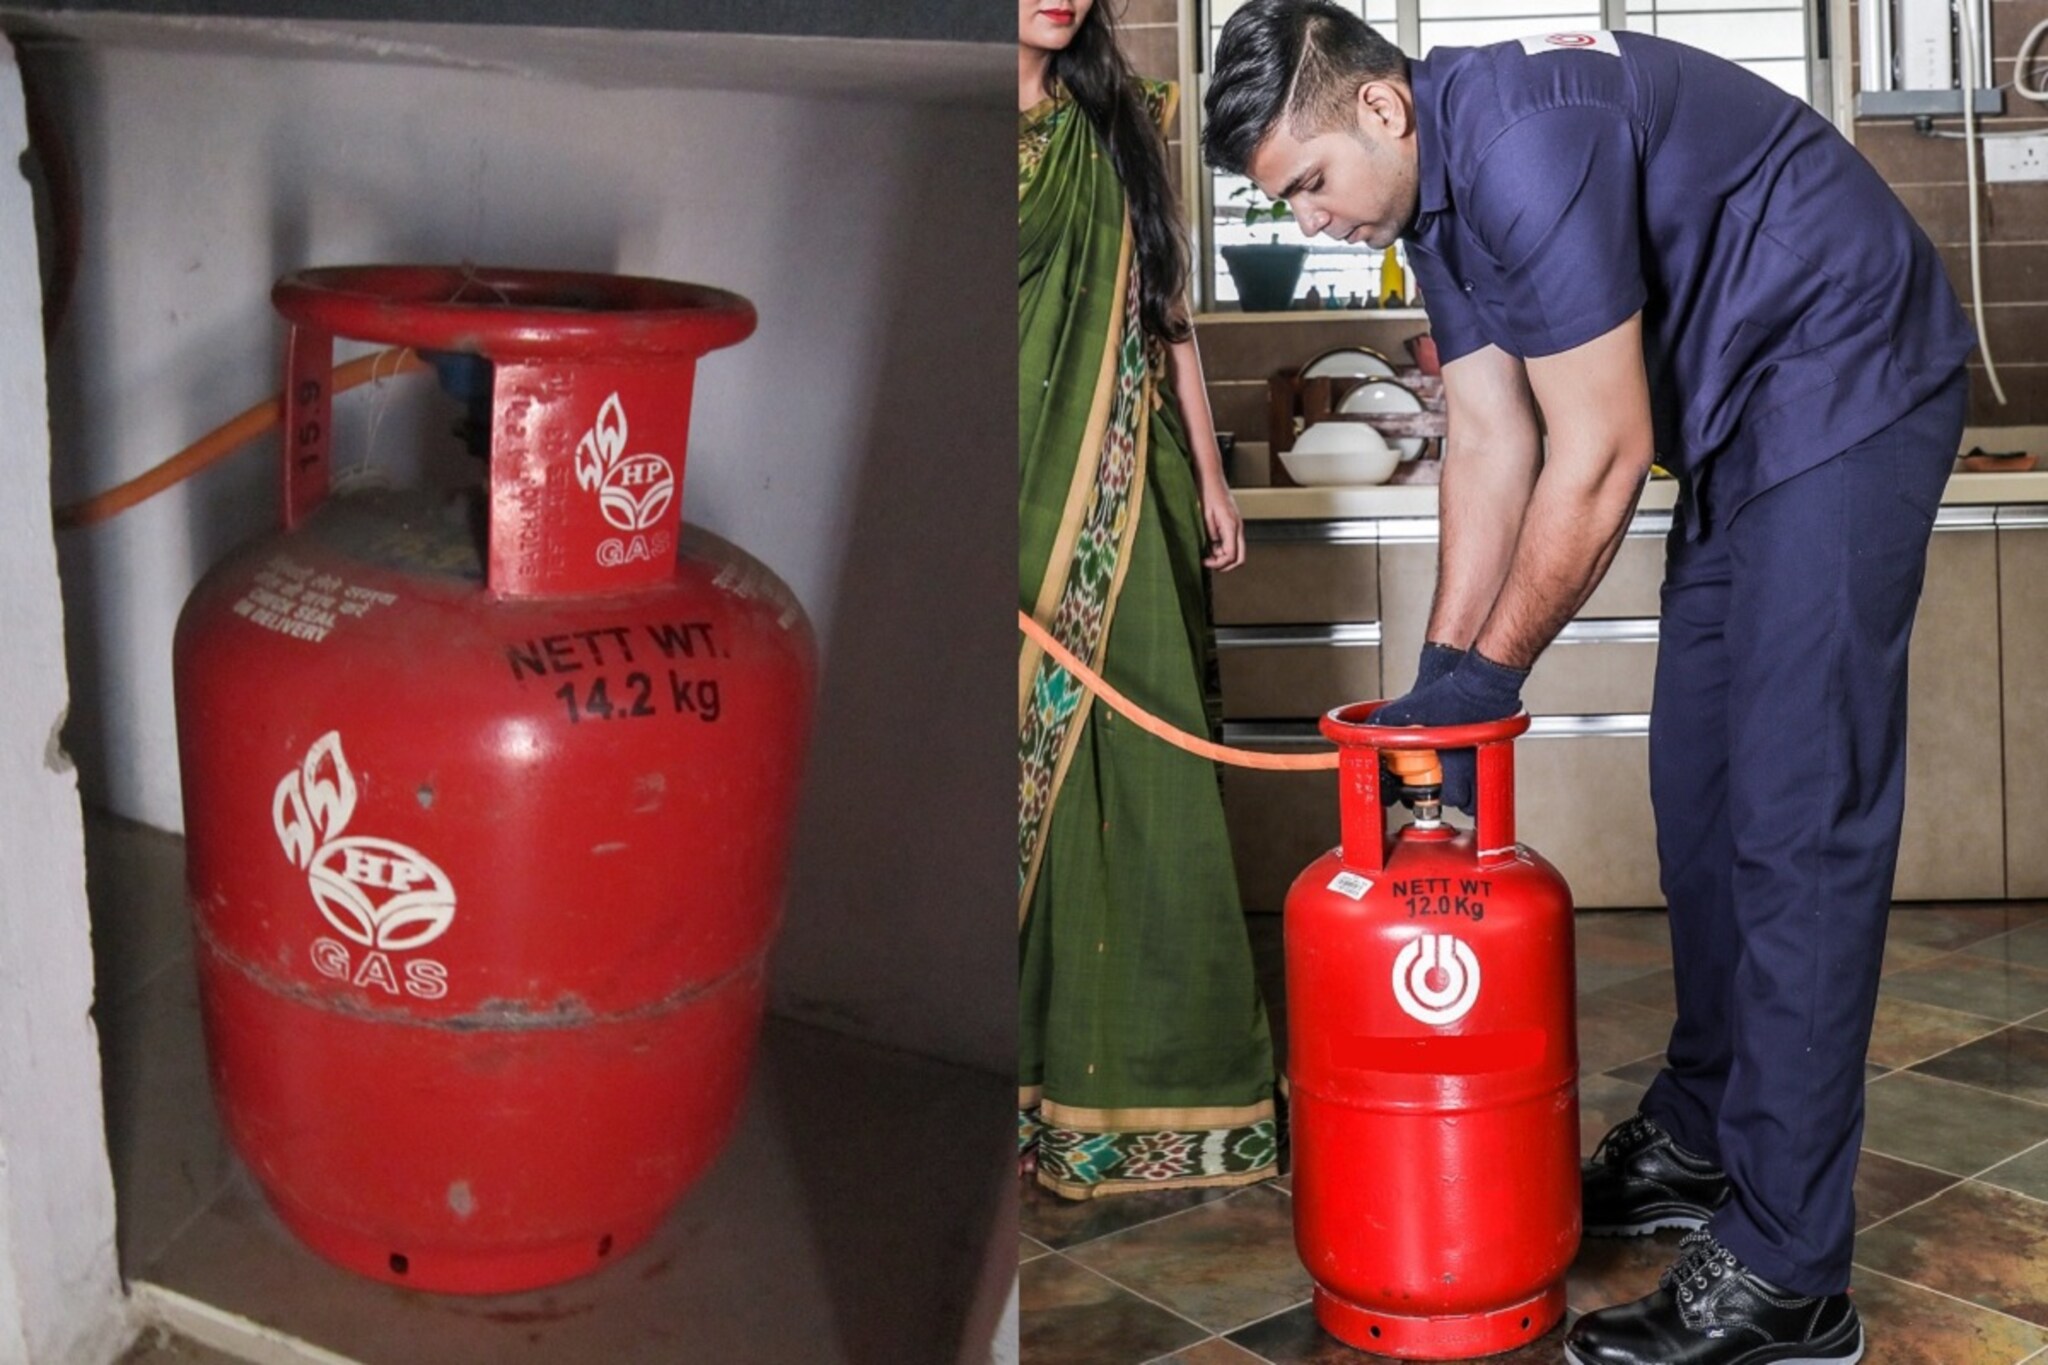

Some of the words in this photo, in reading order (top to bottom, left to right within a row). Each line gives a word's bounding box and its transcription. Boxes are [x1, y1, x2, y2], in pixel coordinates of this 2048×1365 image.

[620, 461, 663, 487] HP
[596, 530, 671, 567] GAS
[249, 607, 329, 644] DELIVERY
[506, 626, 634, 681] NETT
[645, 622, 731, 659] WT.
[555, 671, 656, 724] 14.2
[668, 668, 721, 723] kg
[342, 847, 428, 891] HP
[1392, 877, 1451, 898] NETT
[1459, 878, 1493, 898] WT
[1405, 894, 1451, 919] 12.0
[1454, 895, 1485, 922] Kg
[310, 937, 448, 1000] GAS
